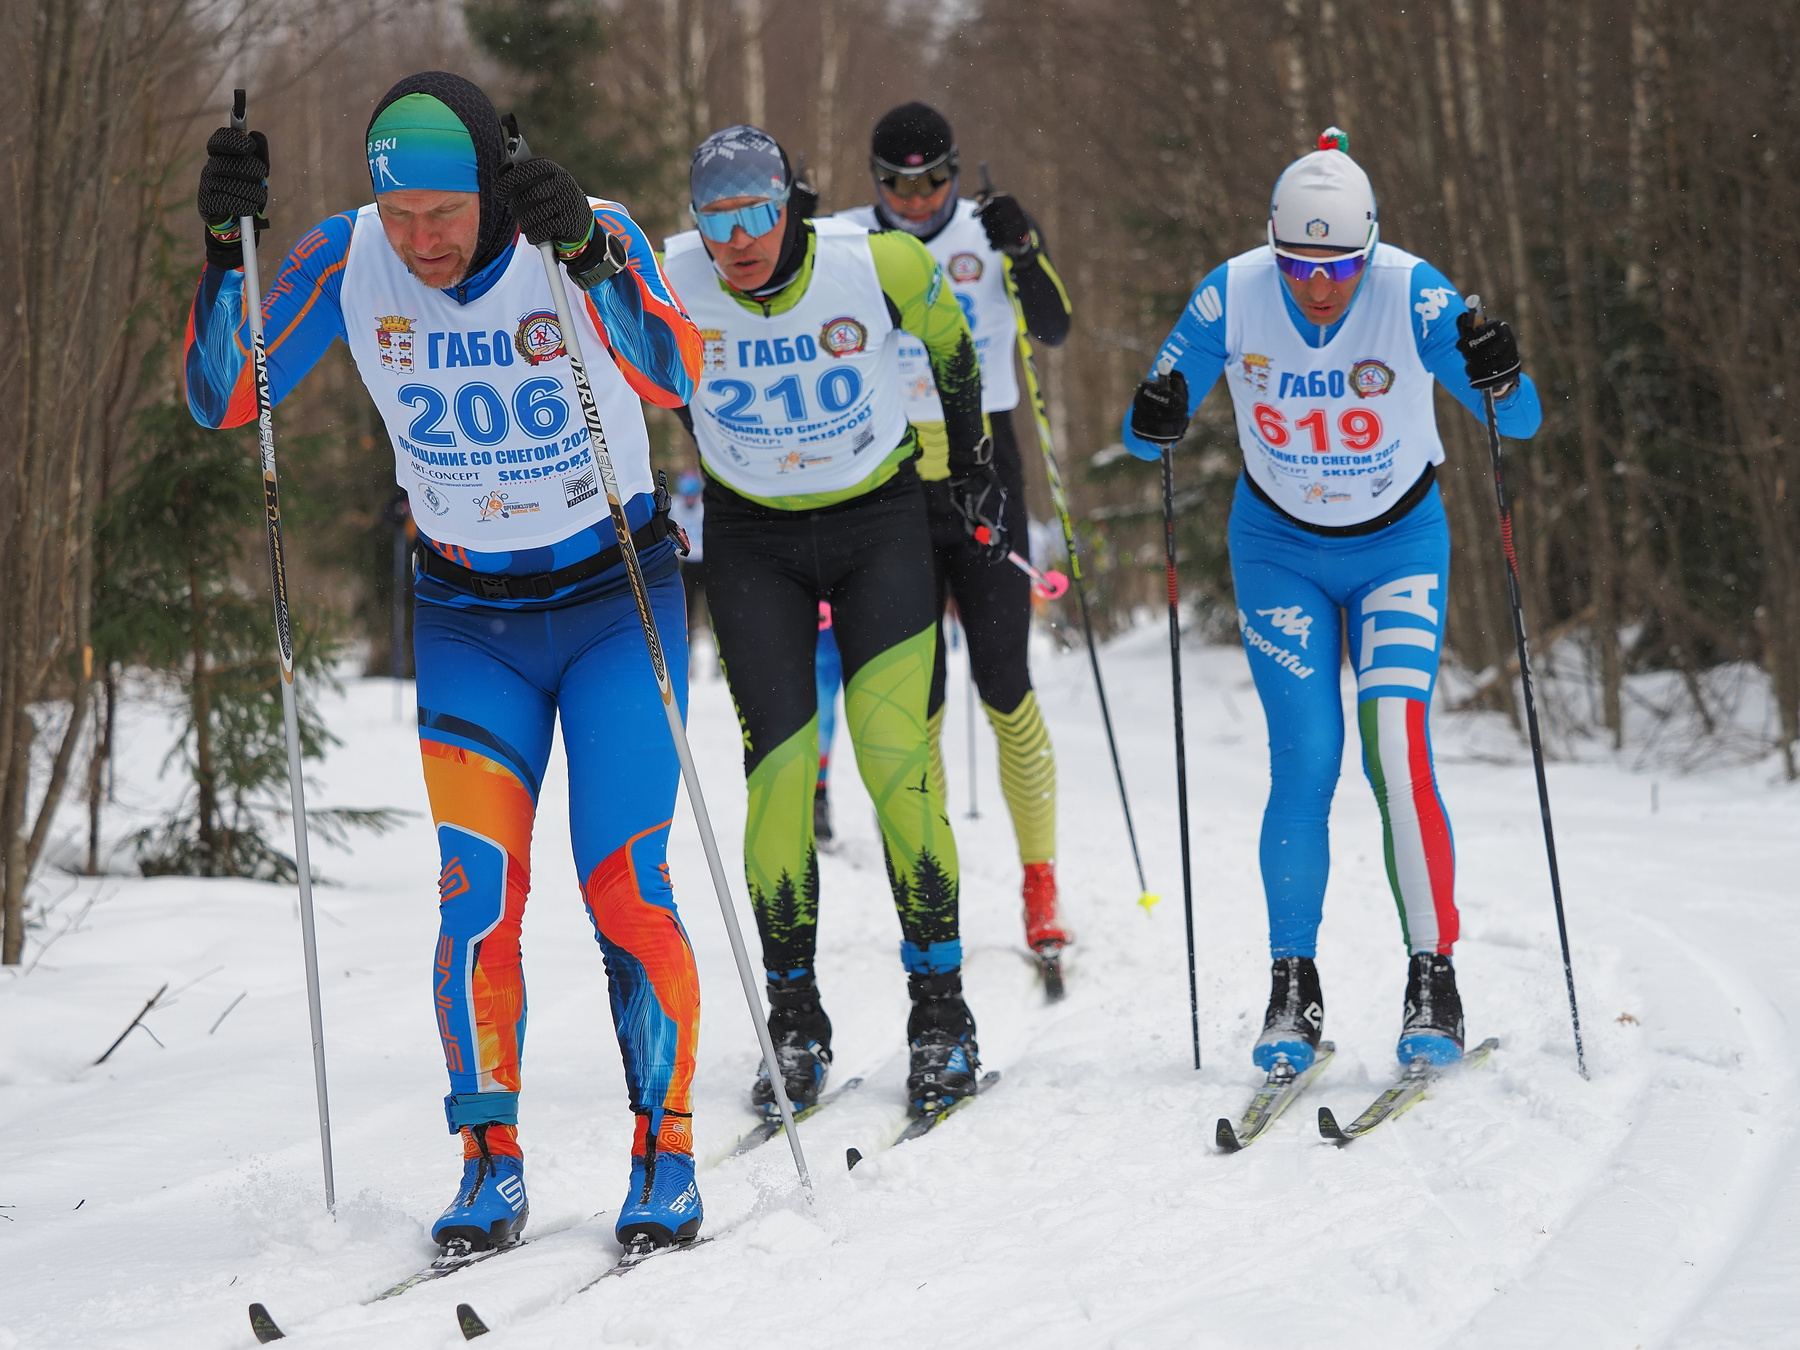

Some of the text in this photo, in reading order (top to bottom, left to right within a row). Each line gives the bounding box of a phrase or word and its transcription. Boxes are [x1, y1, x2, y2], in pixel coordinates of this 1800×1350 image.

[374, 137, 397, 152] SKI
[427, 330, 514, 370] ГАБО
[738, 334, 817, 368] ГАБО
[707, 365, 863, 425] 210
[1278, 370, 1345, 399] ГАБО
[397, 376, 570, 448] 206
[1252, 402, 1383, 454] 619
[398, 427, 590, 466] ПРОЩАНИЕ СО СНЕГОМ 202
[498, 447, 589, 482] SKISPORT
[1301, 455, 1318, 465] СО
[1322, 454, 1372, 466] СНЕГОМ
[410, 461, 480, 481] ART-CONCEPT
[1242, 624, 1315, 680] sportful
[1359, 573, 1438, 692] ITA
[436, 934, 464, 1073] SPINE
[669, 1181, 696, 1214] SPINE
